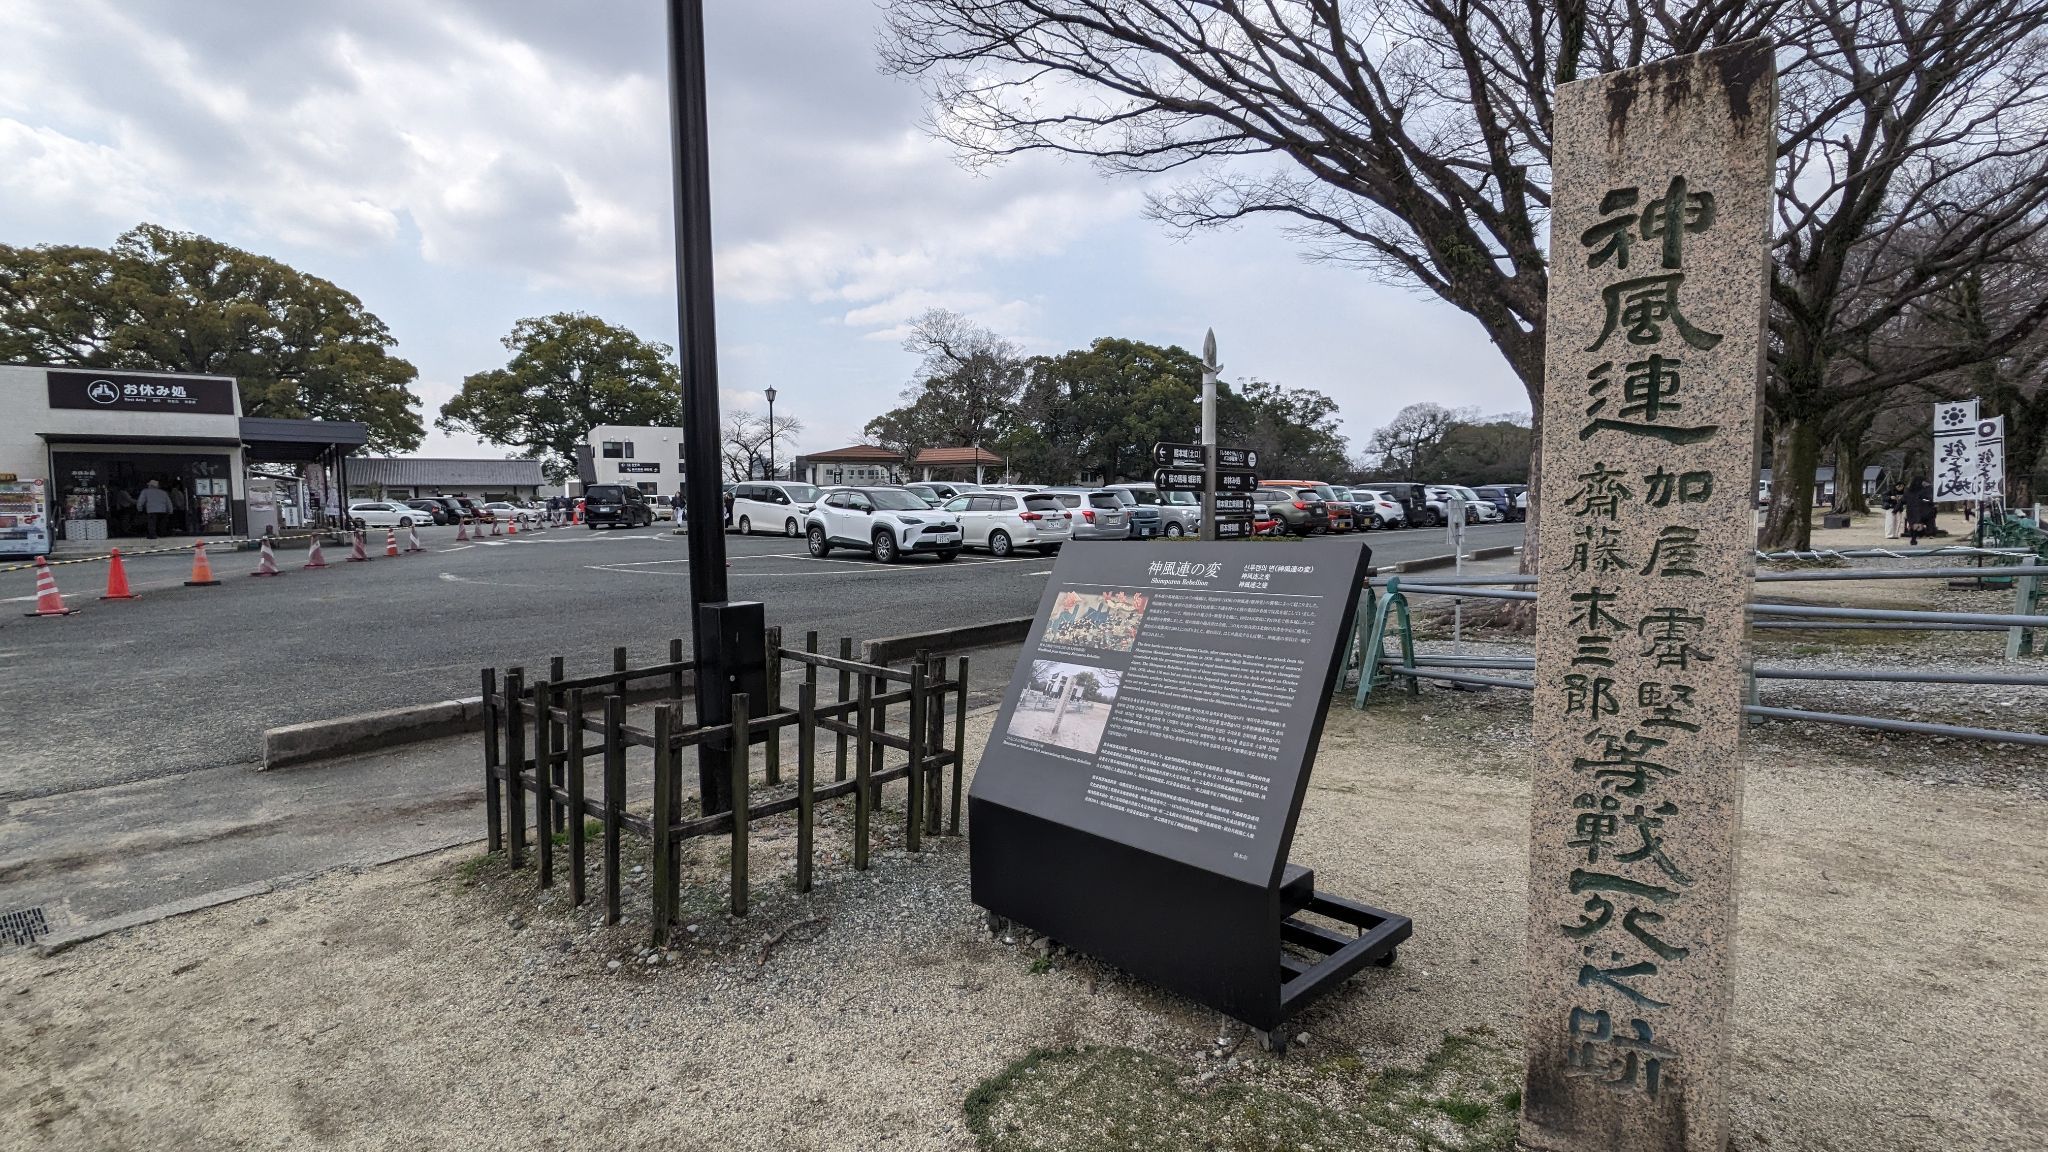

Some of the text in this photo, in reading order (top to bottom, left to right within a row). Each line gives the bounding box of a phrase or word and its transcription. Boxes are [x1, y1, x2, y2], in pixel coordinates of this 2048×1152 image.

[1579, 174, 1724, 445] 神風連
[123, 384, 187, 398] お休み処
[1148, 561, 1223, 578] 神風連の変
[1182, 579, 1209, 587] Rebellion
